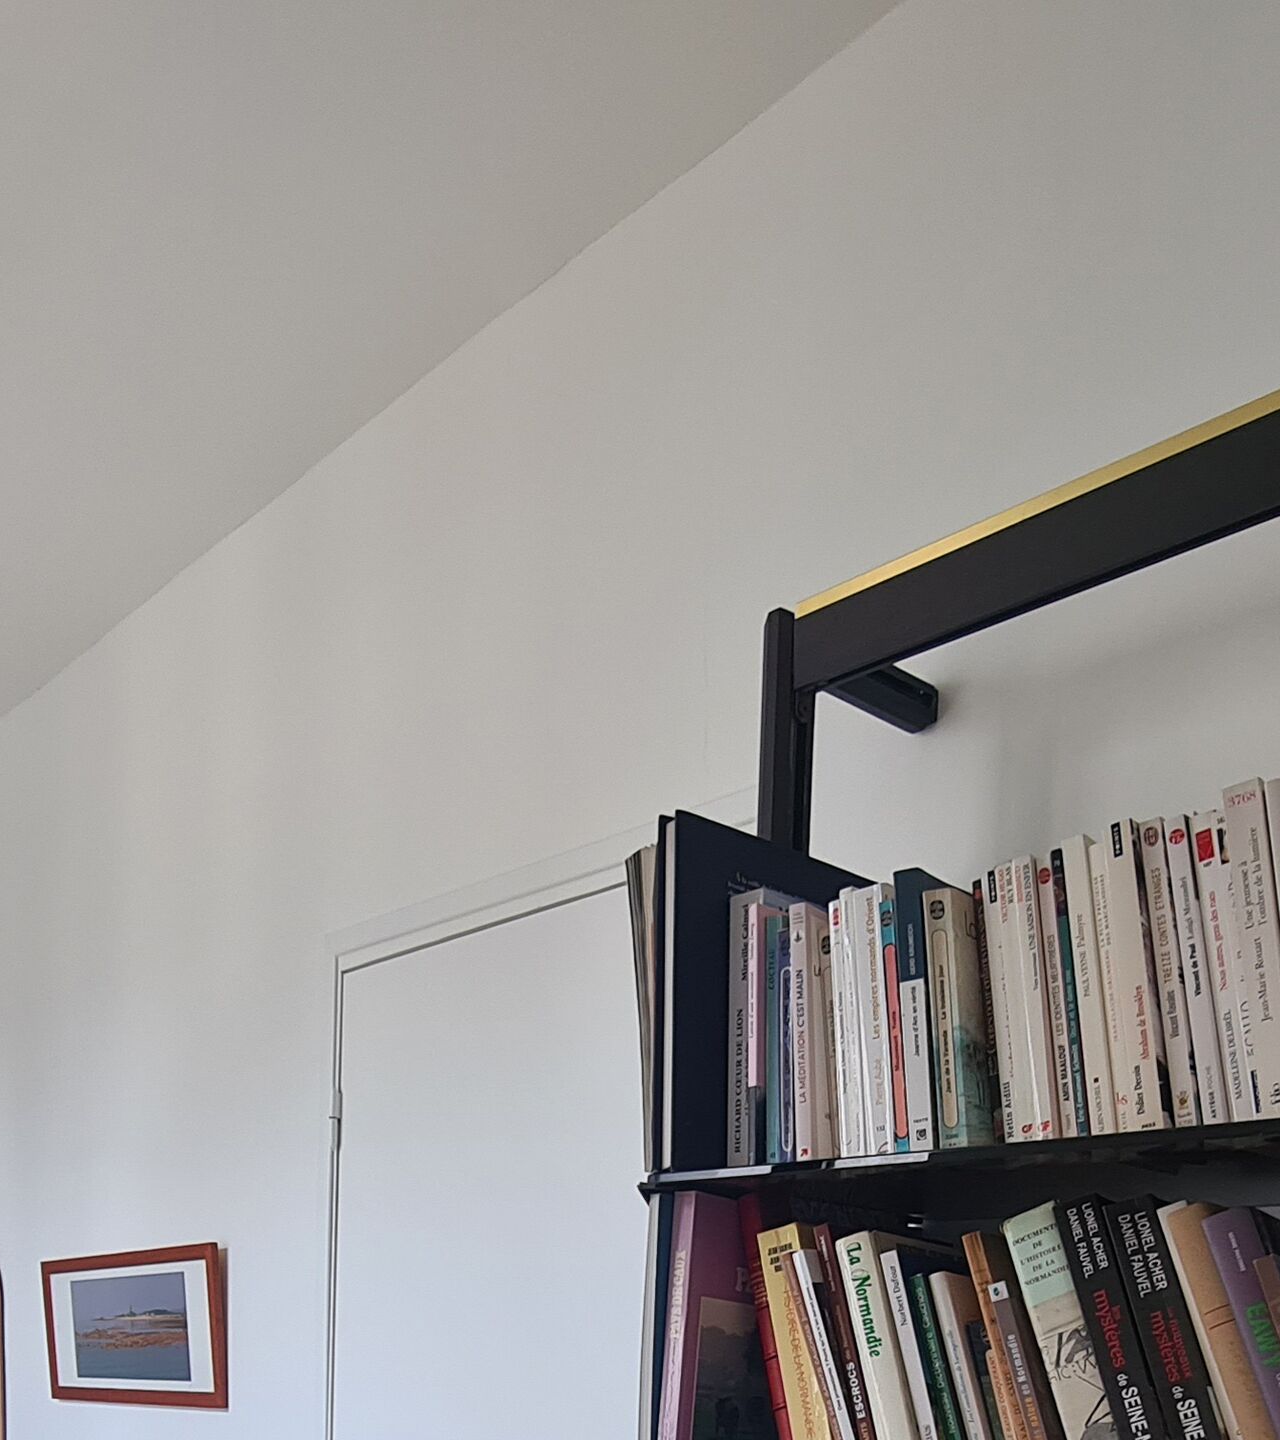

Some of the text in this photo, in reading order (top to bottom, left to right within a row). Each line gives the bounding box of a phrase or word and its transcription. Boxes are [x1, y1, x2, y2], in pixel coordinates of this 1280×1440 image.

[1247, 826, 1262, 862] lumière
[998, 868, 1006, 894] HUGO
[1022, 863, 1031, 889] ENFER
[1254, 877, 1264, 887] de
[1244, 910, 1255, 930] Une
[865, 896, 881, 1040] Les empires normands d'Orient
[1157, 914, 1173, 984] TREIZE CONTES
[1082, 976, 1091, 997] PAUL
[1253, 937, 1274, 1022] Jean-Marie Rouart
[736, 1041, 743, 1056] DE
[795, 969, 806, 1104] LA MÉDITATION C'EST MALIN
[913, 1034, 921, 1057] Jeanne
[1055, 1022, 1064, 1036] LES
[735, 1059, 743, 1096] CŒUR
[1003, 1081, 1012, 1109] Arditi
[1058, 1044, 1071, 1102] AMIN MAALOUF
[1227, 1046, 1243, 1100] MADELEINE
[1135, 1091, 1145, 1116] Didier
[1032, 1239, 1043, 1249] DE
[1066, 1207, 1095, 1279] DANIEL FAUVEL
[1081, 1202, 1109, 1270] LIONEL ACHER
[1117, 1213, 1154, 1299] DANIEL FAUVEL
[1133, 1211, 1169, 1292] LIONEL ACHER
[670, 1251, 687, 1339] PAYS CAUX
[846, 1241, 881, 1358] La Normandie
[889, 1264, 909, 1327] Norbert Dufour
[1092, 1288, 1127, 1370] mystères
[1148, 1309, 1180, 1383] mystères
[1170, 1318, 1193, 1380] nouveaux
[1005, 1333, 1027, 1383] Normandie
[1116, 1373, 1127, 1388] de
[848, 1360, 866, 1419] ESCROCS
[937, 1391, 958, 1434] Nouveau
[1171, 1385, 1183, 1401] de
